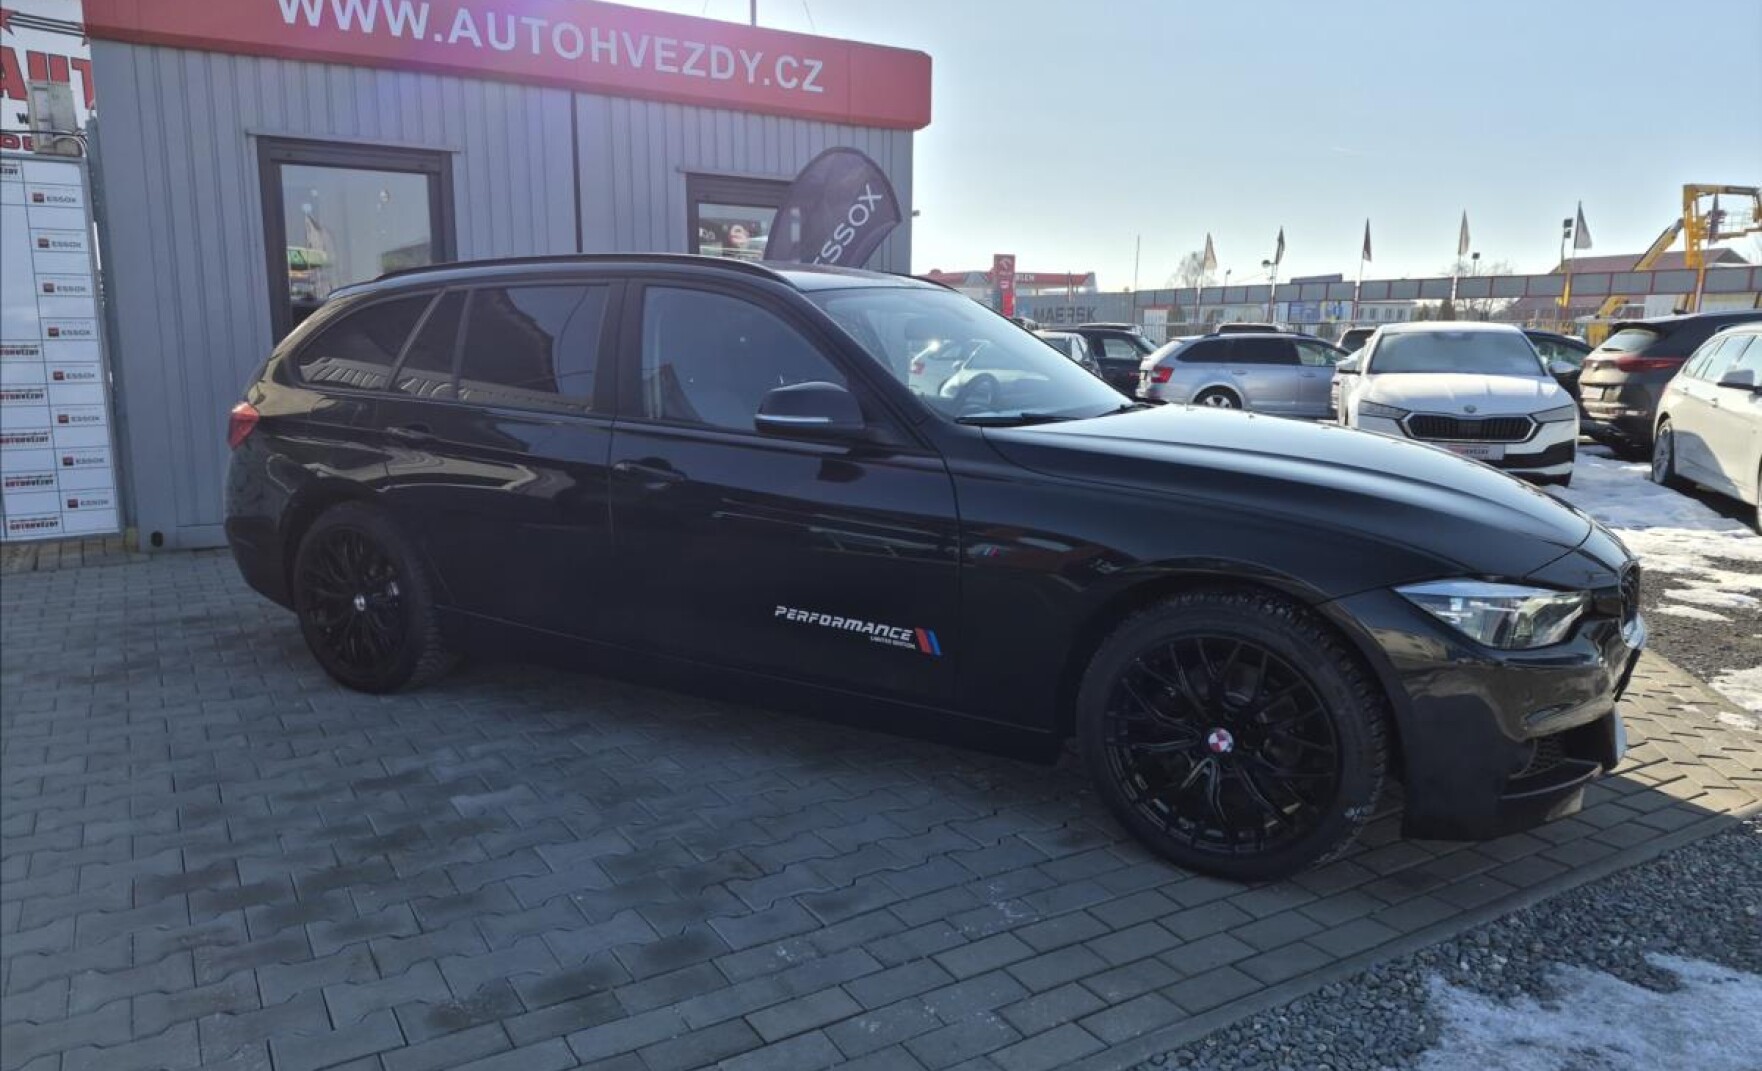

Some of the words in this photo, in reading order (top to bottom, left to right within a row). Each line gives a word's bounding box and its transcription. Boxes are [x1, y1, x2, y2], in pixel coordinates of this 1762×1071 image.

[278, 0, 824, 93] WWW.AUTOHVEZDY.CZ
[812, 183, 882, 265] SSOX
[774, 605, 914, 641] PERFORMANCE
